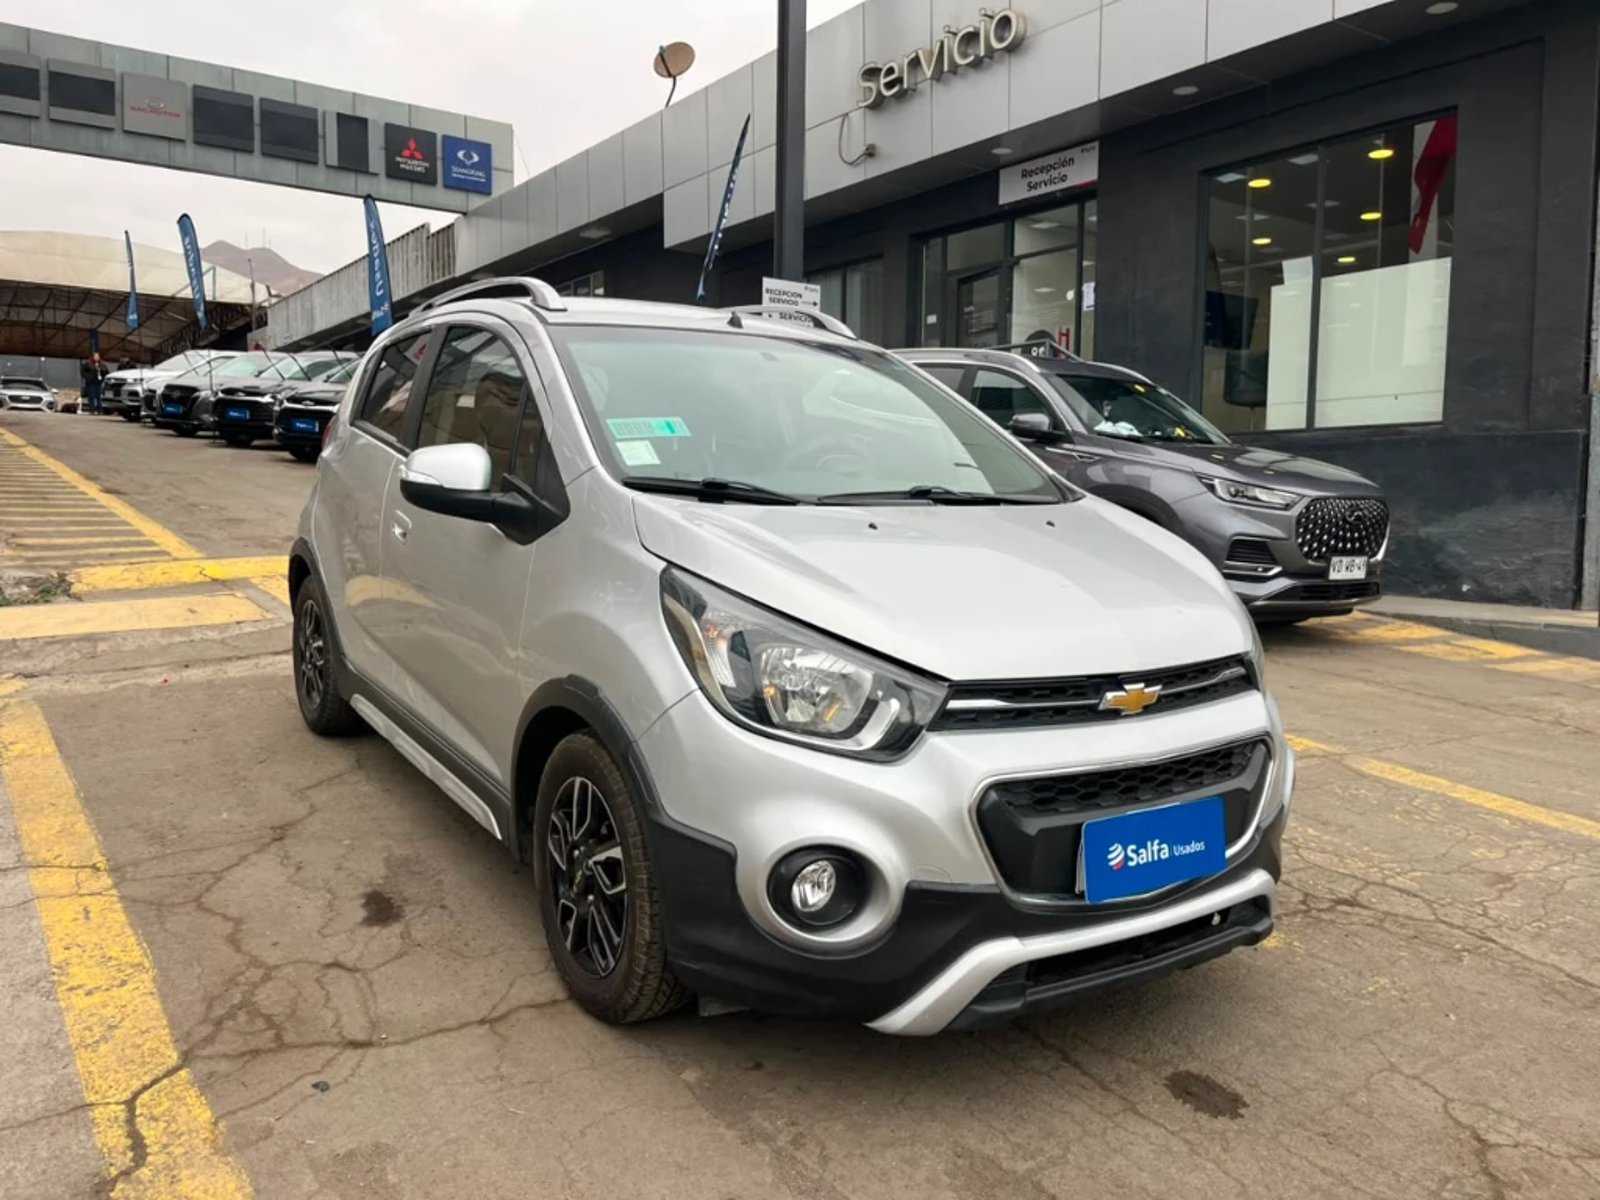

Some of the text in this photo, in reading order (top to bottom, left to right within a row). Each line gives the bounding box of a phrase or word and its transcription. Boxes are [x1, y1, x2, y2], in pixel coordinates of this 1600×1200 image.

[856, 7, 1024, 110] Servicio
[1021, 156, 1075, 179] Recepción
[1026, 171, 1068, 192] Servicio
[1126, 839, 1206, 867] Salfa Usados
